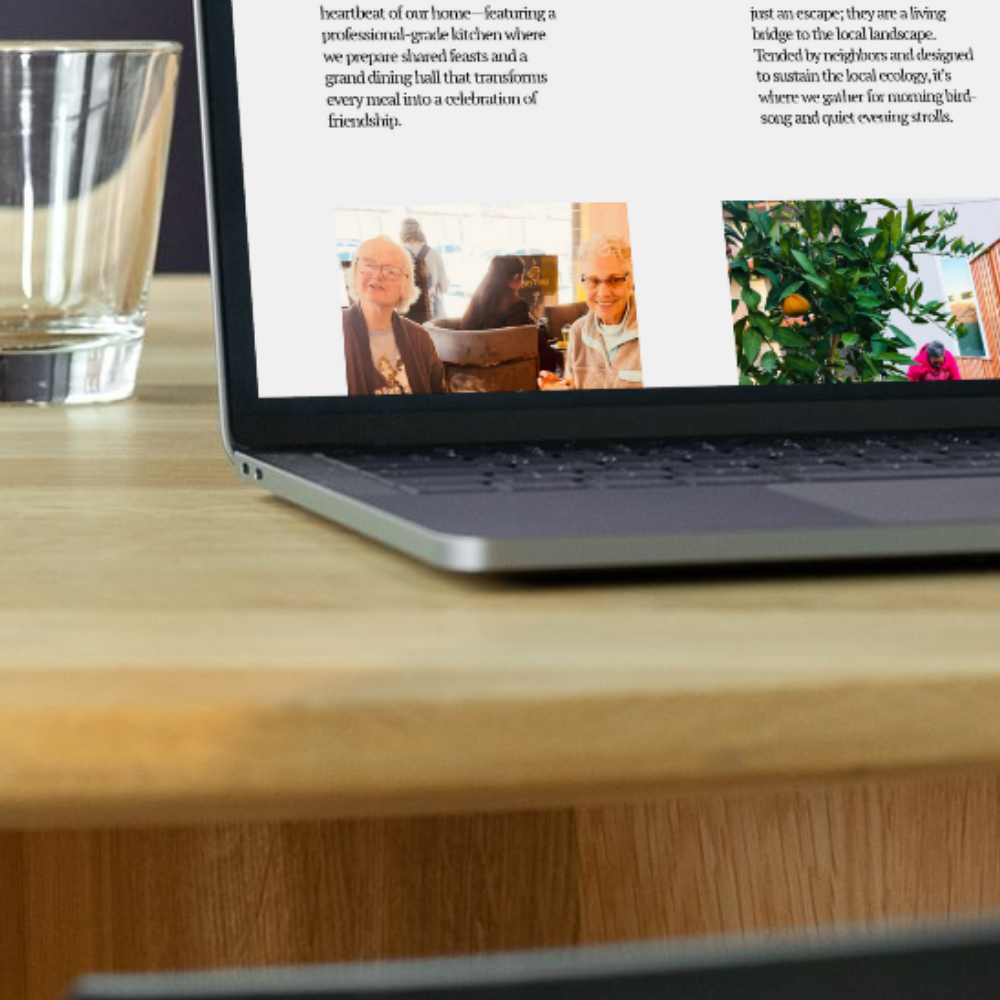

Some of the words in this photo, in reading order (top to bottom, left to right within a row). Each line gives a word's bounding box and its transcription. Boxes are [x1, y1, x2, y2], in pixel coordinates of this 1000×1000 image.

[320, 5, 384, 19] heartbeat
[389, 5, 403, 20] of
[405, 10, 429, 20] our
[548, 10, 556, 20] a
[750, 7, 773, 22] just
[777, 10, 794, 19] an
[796, 10, 844, 22] escape;
[846, 7, 875, 22] they
[877, 10, 897, 19] are
[900, 10, 907, 19] a
[910, 6, 946, 22] living
[322, 27, 449, 44] professional-grade
[451, 27, 502, 40] kitchen
[505, 27, 546, 40] where
[752, 27, 793, 43] bridge
[796, 30, 810, 40] to
[812, 27, 834, 40] the
[836, 27, 866, 40] local
[869, 27, 936, 43] landscape.
[324, 54, 343, 62] we
[346, 53, 398, 66] prepare
[401, 49, 447, 62] shared
[450, 49, 489, 62] feasts
[492, 49, 516, 62] and
[519, 52, 528, 62] a
[754, 48, 802, 62] Tended
[805, 49, 821, 64] by
[823, 48, 887, 64] neighbors
[890, 47, 914, 61] and
[916, 47, 973, 64] designed
[325, 70, 365, 87] grand
[368, 70, 412, 87] dining
[415, 70, 441, 84] hall
[444, 70, 471, 84] that
[474, 70, 547, 84] transforms
[757, 71, 770, 82] to
[773, 69, 820, 82] sustain
[822, 69, 843, 82] the
[846, 69, 876, 82] local
[879, 68, 931, 84] ecology,
[327, 96, 364, 109] every
[366, 92, 401, 106] meal
[403, 92, 432, 106] into
[434, 96, 442, 106] a
[445, 91, 520, 105] celebration
[523, 91, 538, 104] of
[758, 90, 799, 104] where
[801, 94, 820, 103] we
[823, 89, 863, 106] gather
[867, 89, 884, 102] for
[888, 90, 944, 106] morning
[329, 113, 401, 129] friendship.
[761, 115, 792, 127] song
[795, 110, 820, 124] and
[822, 111, 854, 126] quiet
[858, 111, 909, 126] evening
[911, 109, 953, 122] strolls.
